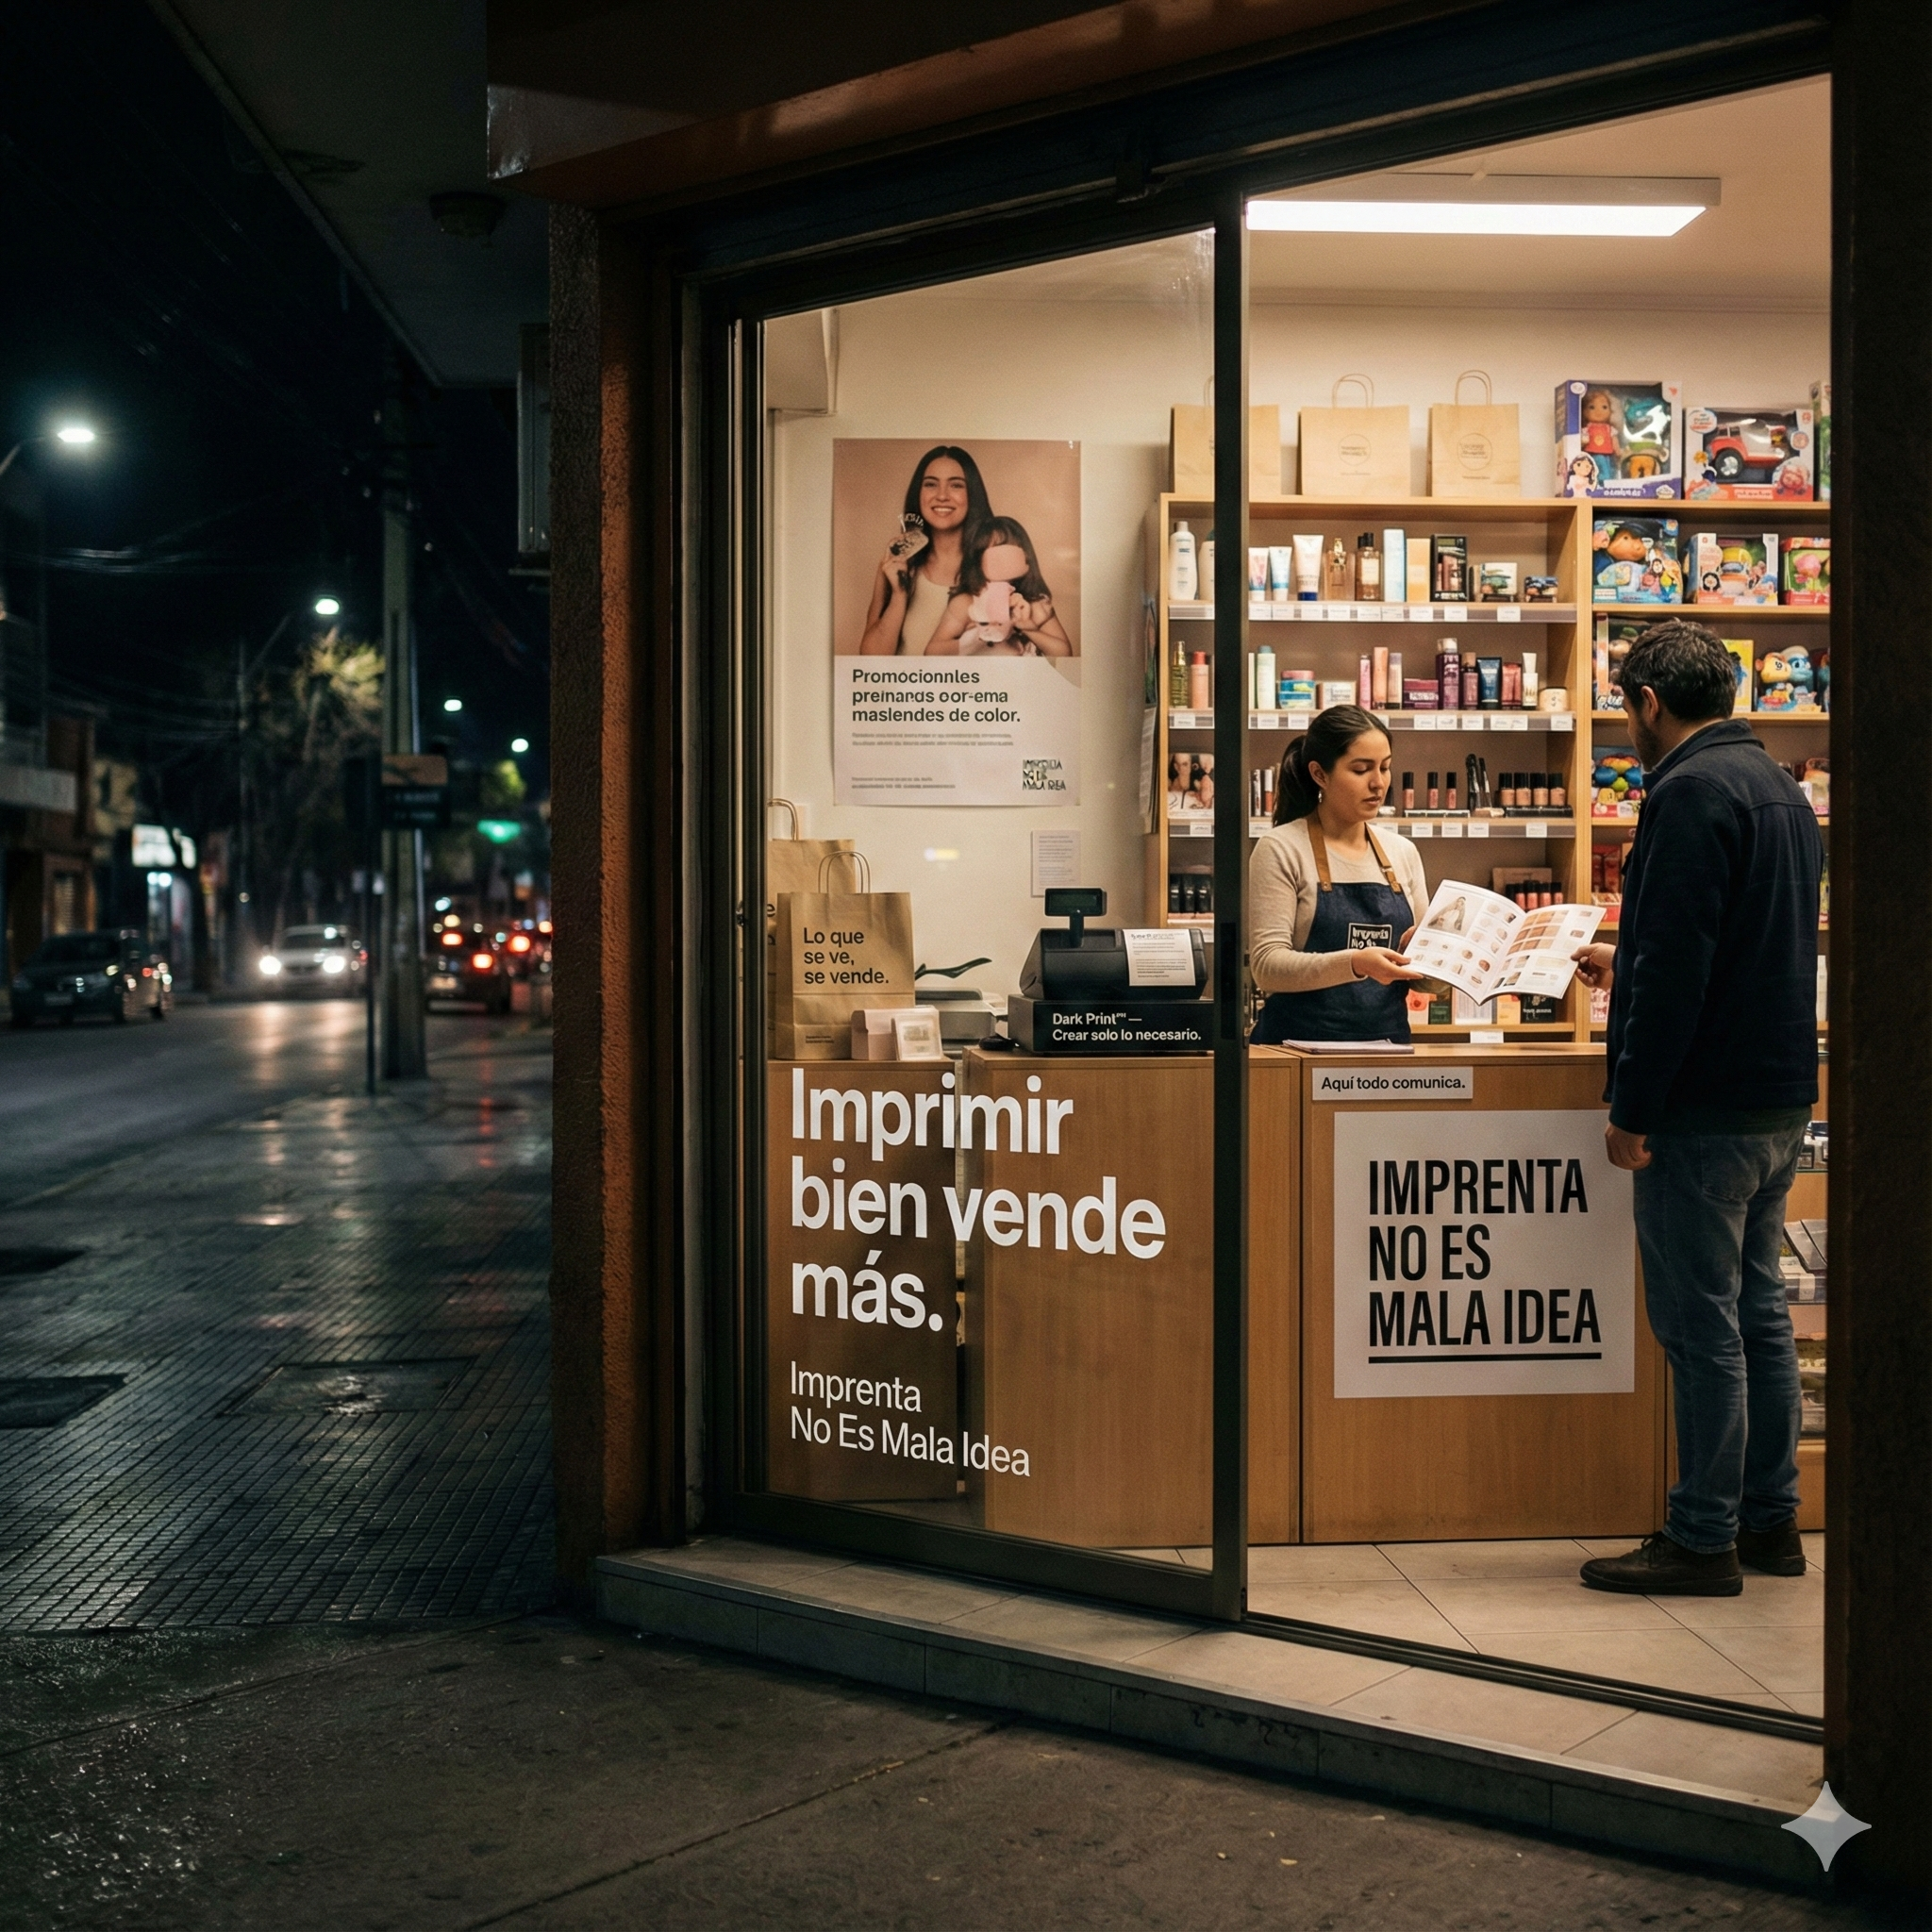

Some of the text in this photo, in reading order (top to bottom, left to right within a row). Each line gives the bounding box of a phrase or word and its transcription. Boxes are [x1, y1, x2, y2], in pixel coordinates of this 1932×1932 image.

[948, 708, 971, 723] de
[974, 707, 1021, 723] color.
[803, 926, 865, 949] Lo que
[804, 951, 855, 966] se ve,
[804, 967, 890, 985] se vende.
[1052, 1027, 1202, 1041] Crear solo lo necesario.
[1053, 1012, 1083, 1025] Dark
[1321, 1074, 1466, 1092] Aquí todo comunica.
[791, 1067, 1074, 1162] Imprimir
[791, 1155, 1167, 1260] bien vende
[1369, 1158, 1589, 1216] IMPRENTA
[1369, 1224, 1491, 1281] NO ES
[791, 1249, 943, 1333] más.
[1369, 1288, 1602, 1347] MALA IDEA
[791, 1360, 923, 1413] Imprenta
[791, 1406, 1031, 1477] No Es Mala Idea
